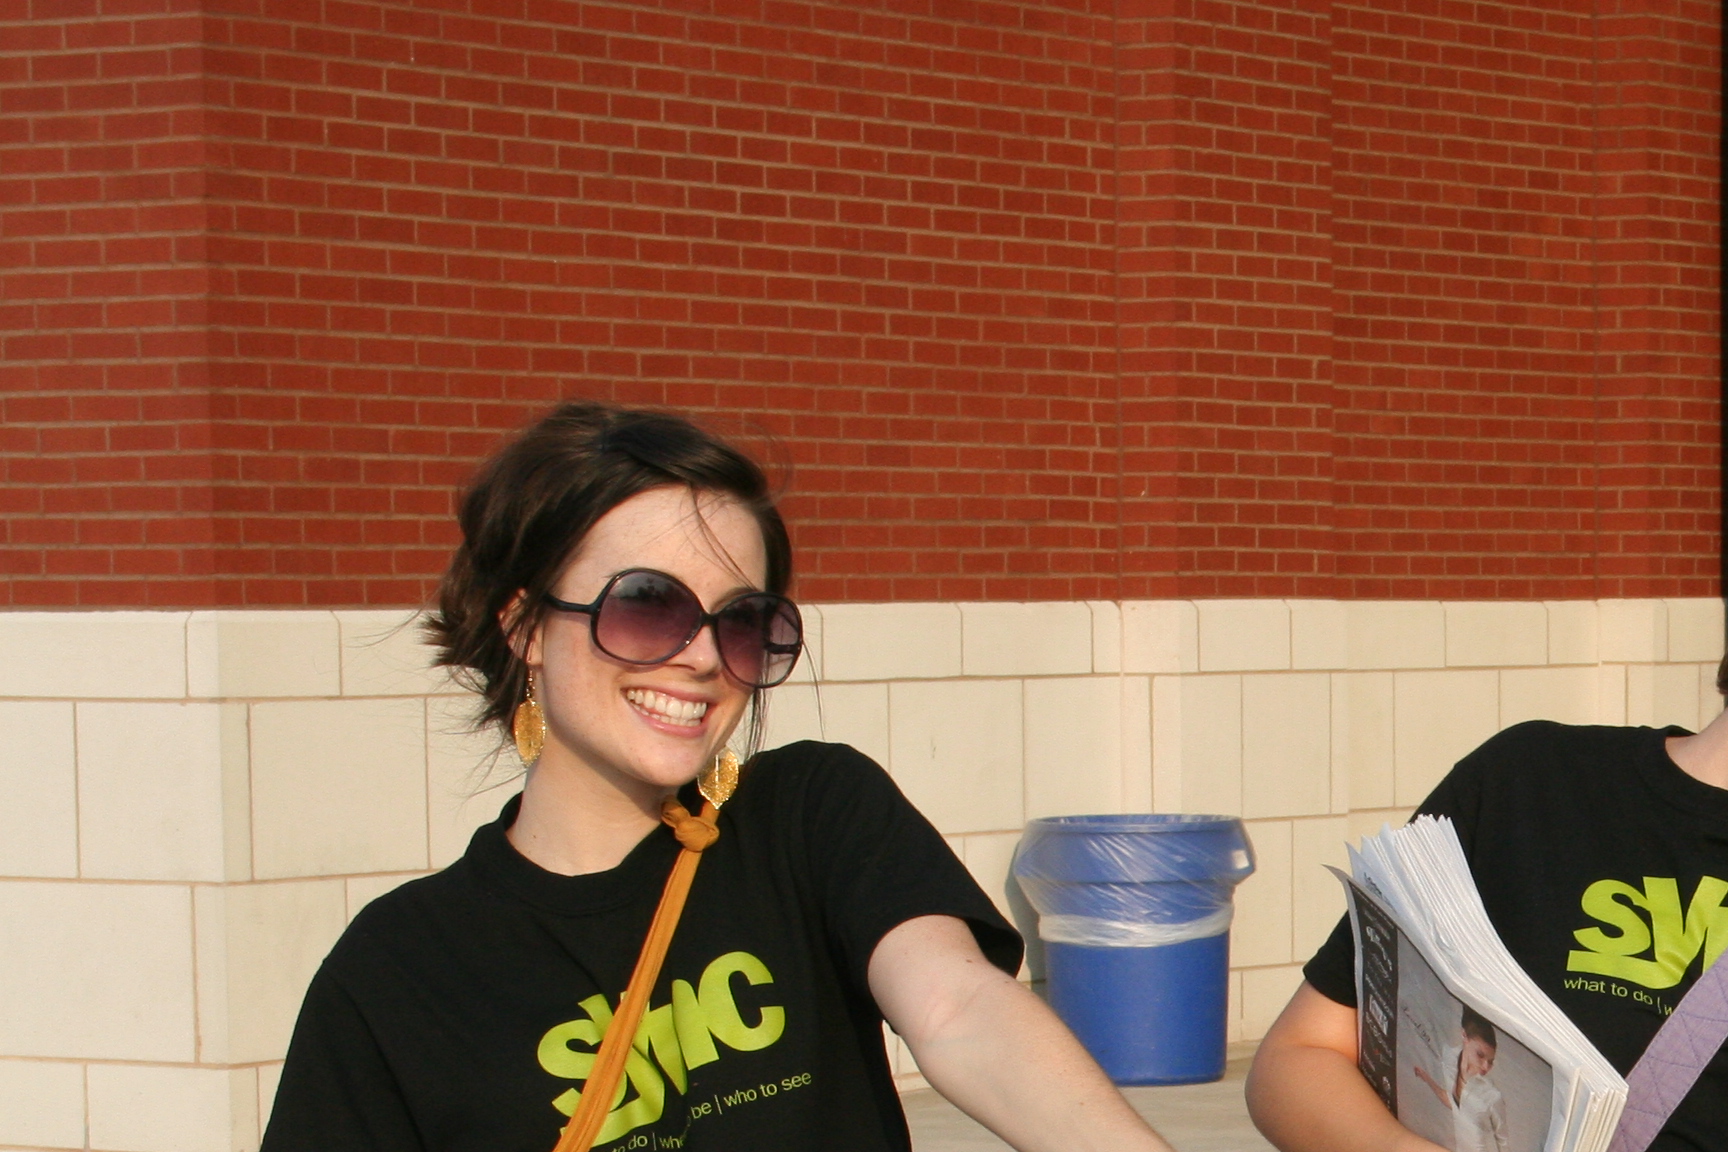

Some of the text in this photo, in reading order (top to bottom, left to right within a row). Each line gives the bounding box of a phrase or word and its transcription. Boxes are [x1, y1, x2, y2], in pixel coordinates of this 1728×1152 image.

[1564, 976, 1606, 994] what
[1610, 983, 1628, 998] to
[1633, 989, 1653, 1006] do
[537, 951, 786, 1147] sync
[628, 1135, 648, 1148] do
[691, 1102, 712, 1120] be
[723, 1089, 757, 1107] who
[760, 1082, 778, 1097] to
[781, 1072, 812, 1091] see
